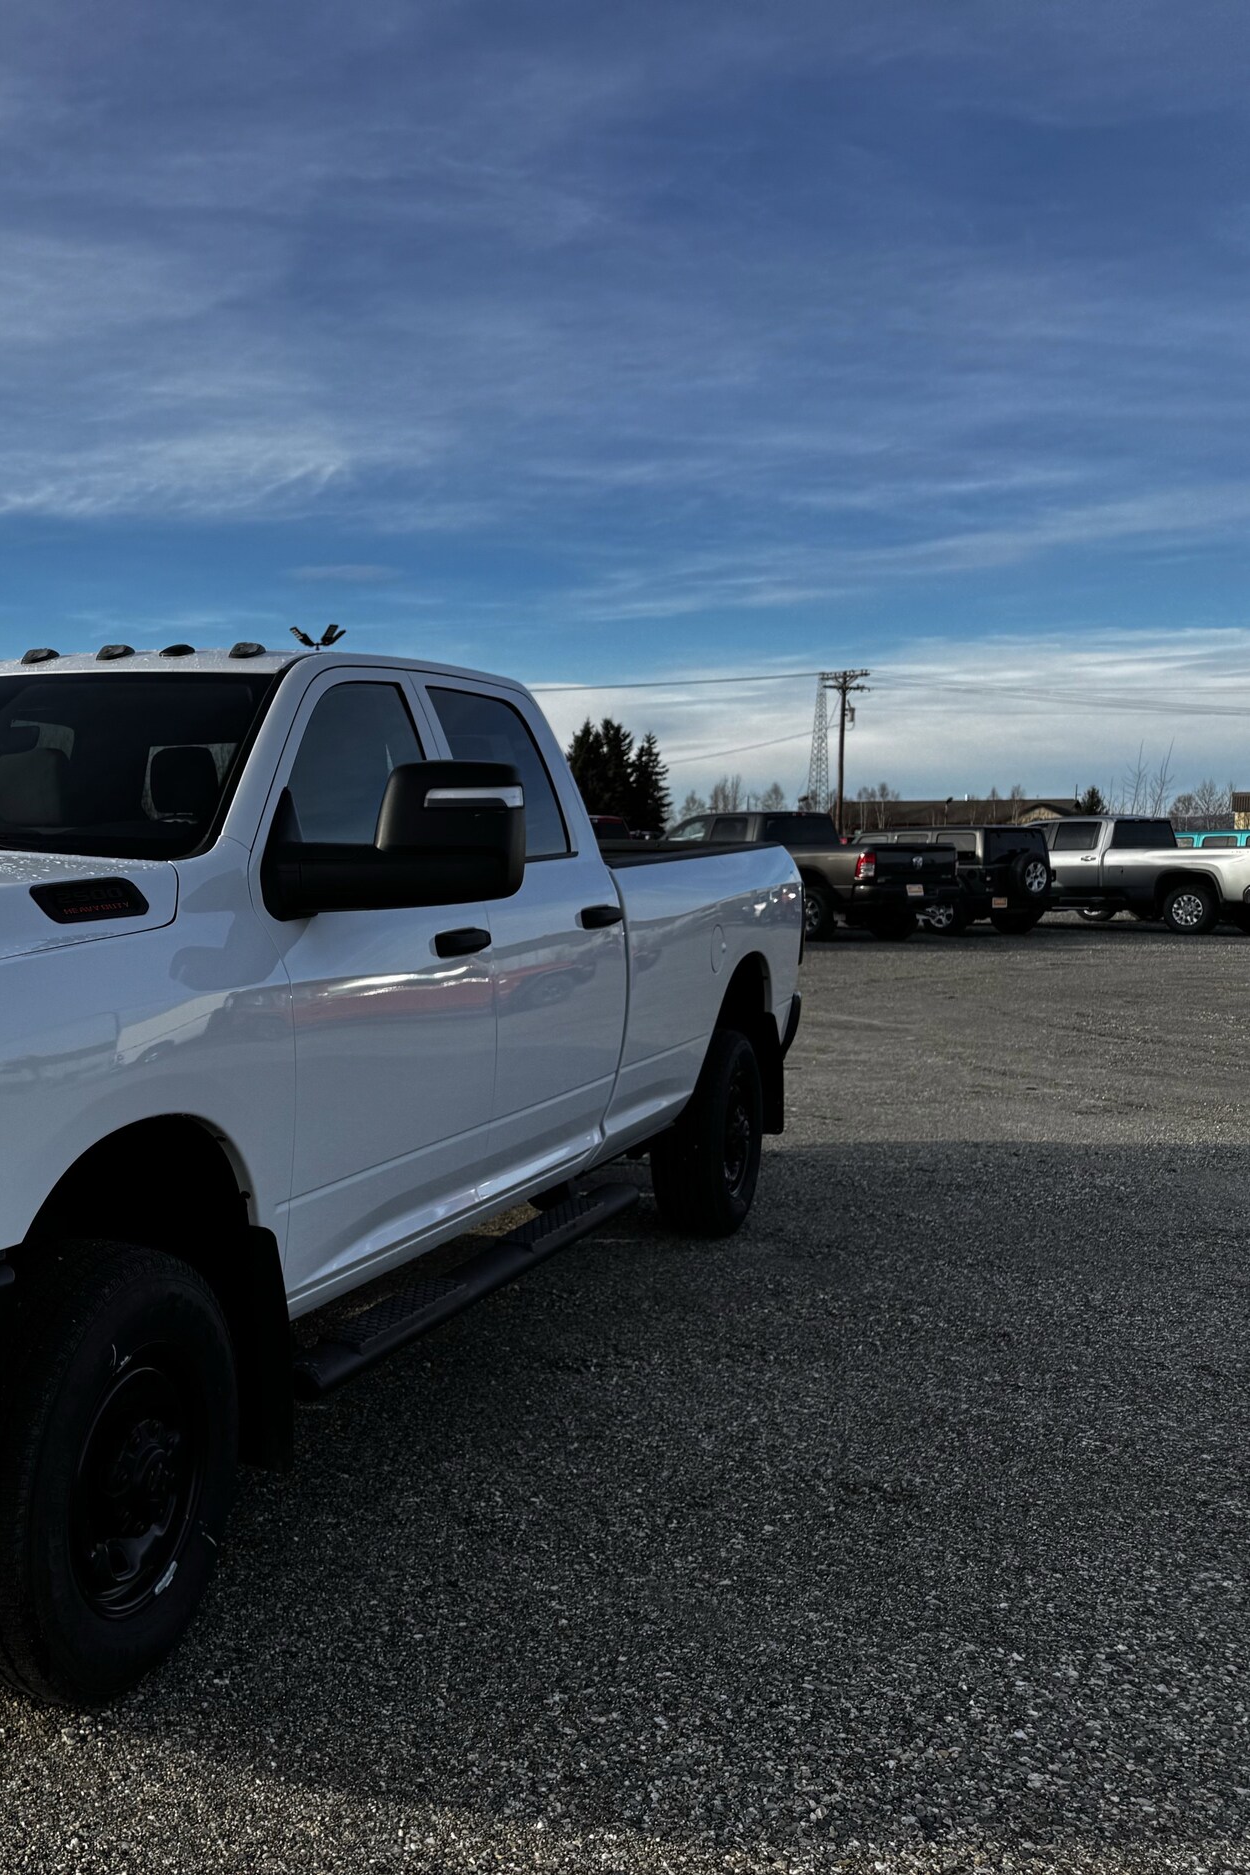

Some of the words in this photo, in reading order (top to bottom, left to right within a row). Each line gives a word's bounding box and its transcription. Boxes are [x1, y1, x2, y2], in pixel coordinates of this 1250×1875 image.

[56, 888, 124, 903] 2500
[63, 905, 99, 915] HEAVY
[100, 901, 130, 911] DUTY
